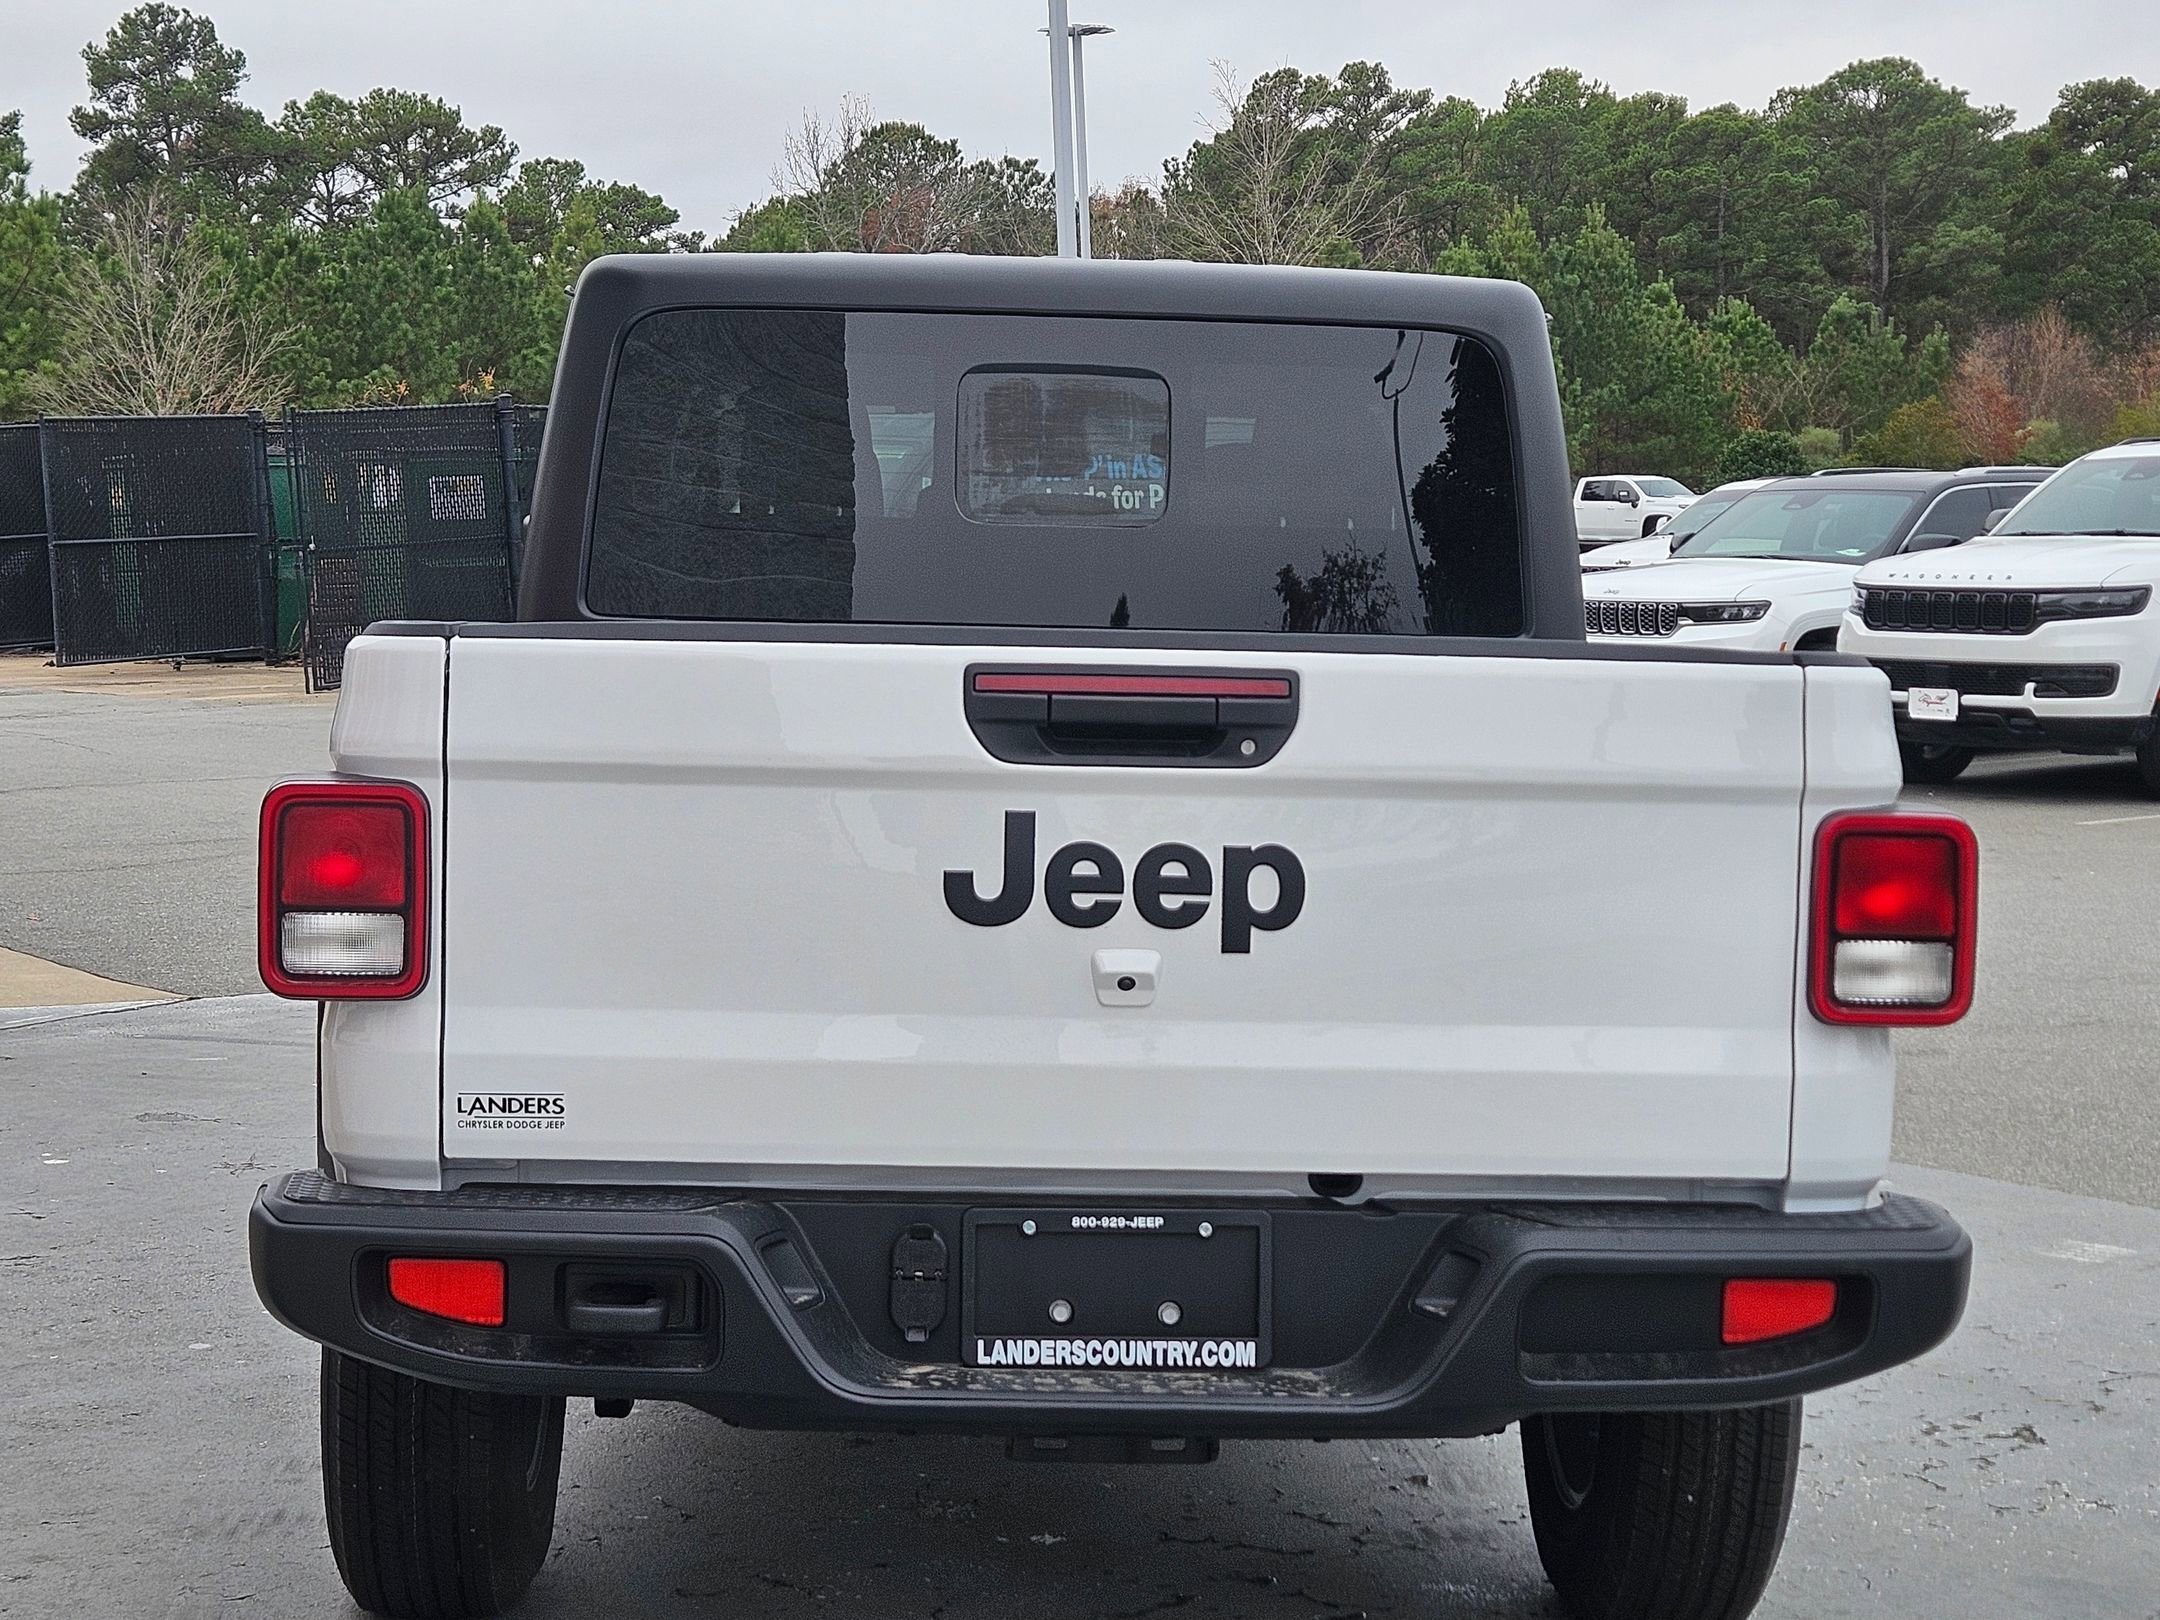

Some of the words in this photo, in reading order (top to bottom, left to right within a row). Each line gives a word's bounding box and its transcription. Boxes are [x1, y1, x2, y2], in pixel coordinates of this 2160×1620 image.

[1111, 484, 1144, 509] for
[1888, 573, 2013, 581] WAGONEER
[943, 809, 1306, 954] Jeep
[457, 1097, 565, 1115] LANDERS
[457, 1120, 504, 1129] CHRYSLER
[506, 1120, 542, 1129] DODGE
[544, 1120, 565, 1129] JEEP
[1071, 1216, 1164, 1229] 800-929-JEEP
[977, 1339, 1256, 1367] LANDERSCOUNTRY.COM
